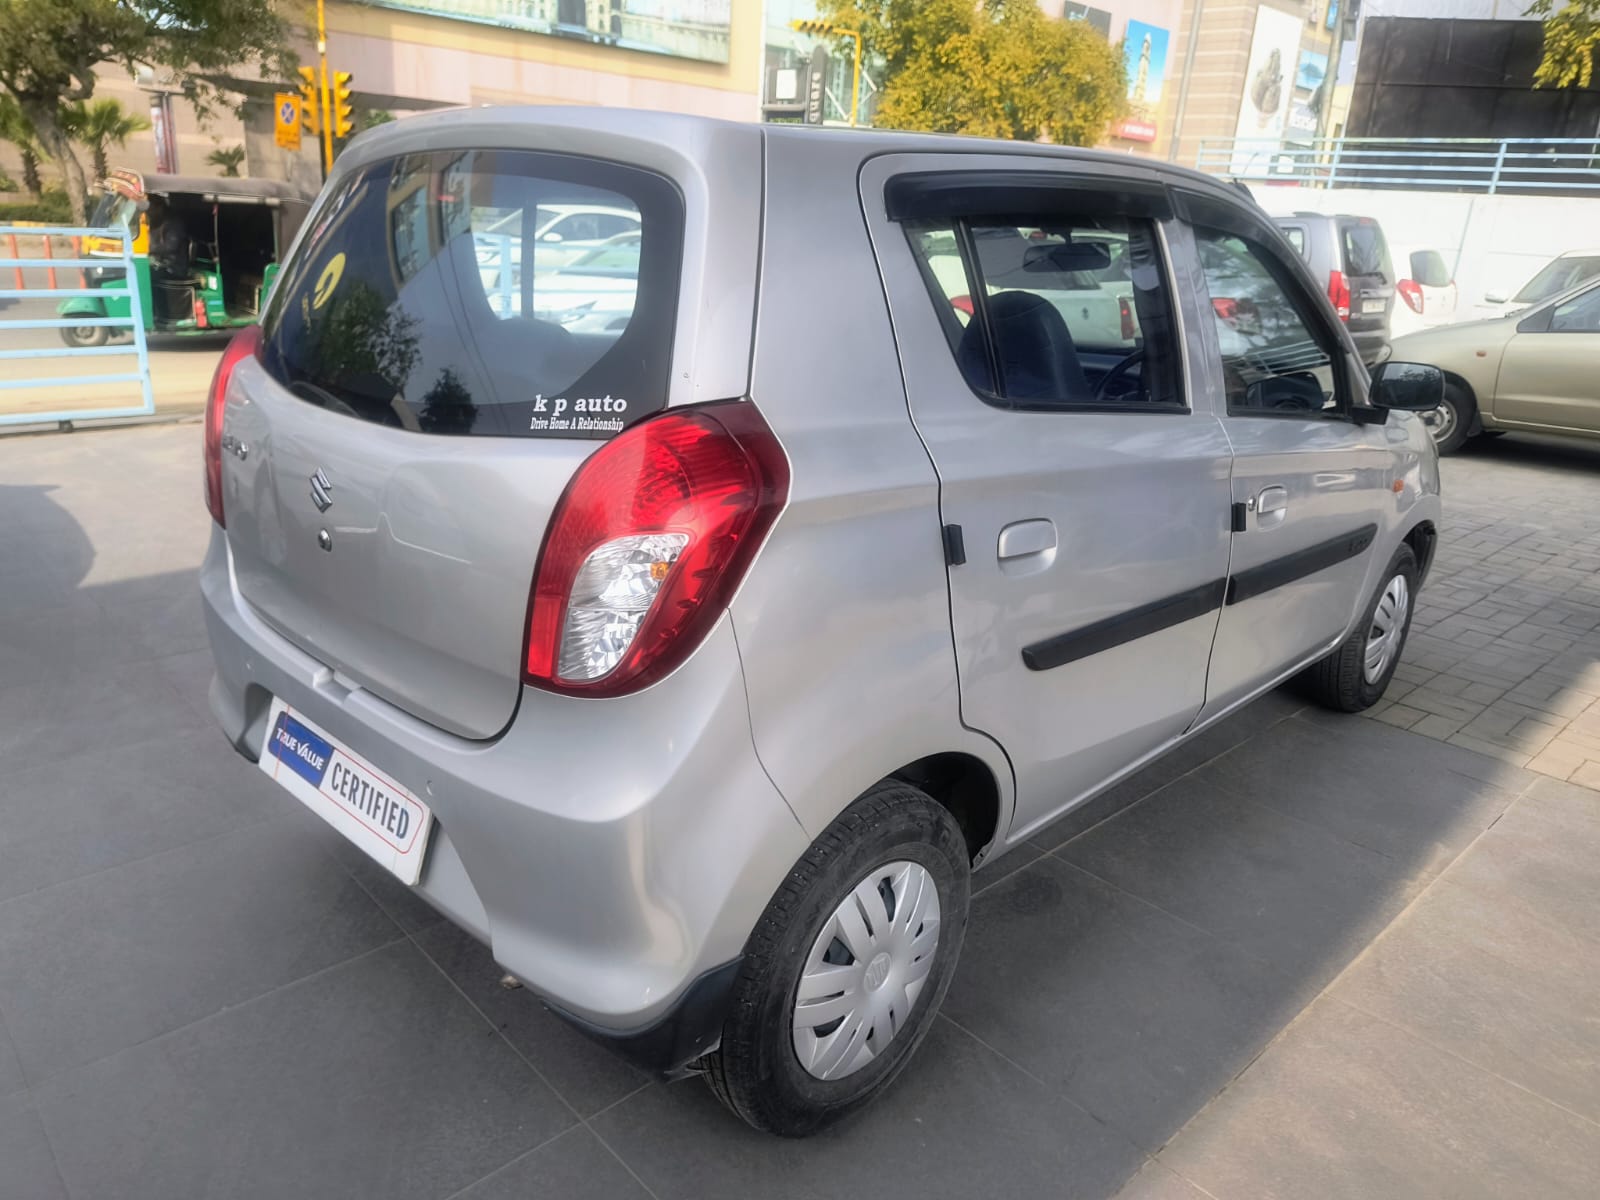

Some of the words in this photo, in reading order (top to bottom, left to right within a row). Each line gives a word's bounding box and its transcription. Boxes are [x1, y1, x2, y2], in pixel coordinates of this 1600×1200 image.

[533, 394, 548, 412] k
[552, 398, 567, 416] p
[574, 395, 627, 413] auto
[530, 417, 549, 430] Drive
[549, 417, 569, 430] Home
[570, 418, 576, 430] A
[577, 417, 624, 432] Relationship
[297, 742, 324, 770] VALUE
[331, 762, 410, 839] CERTIFIED
